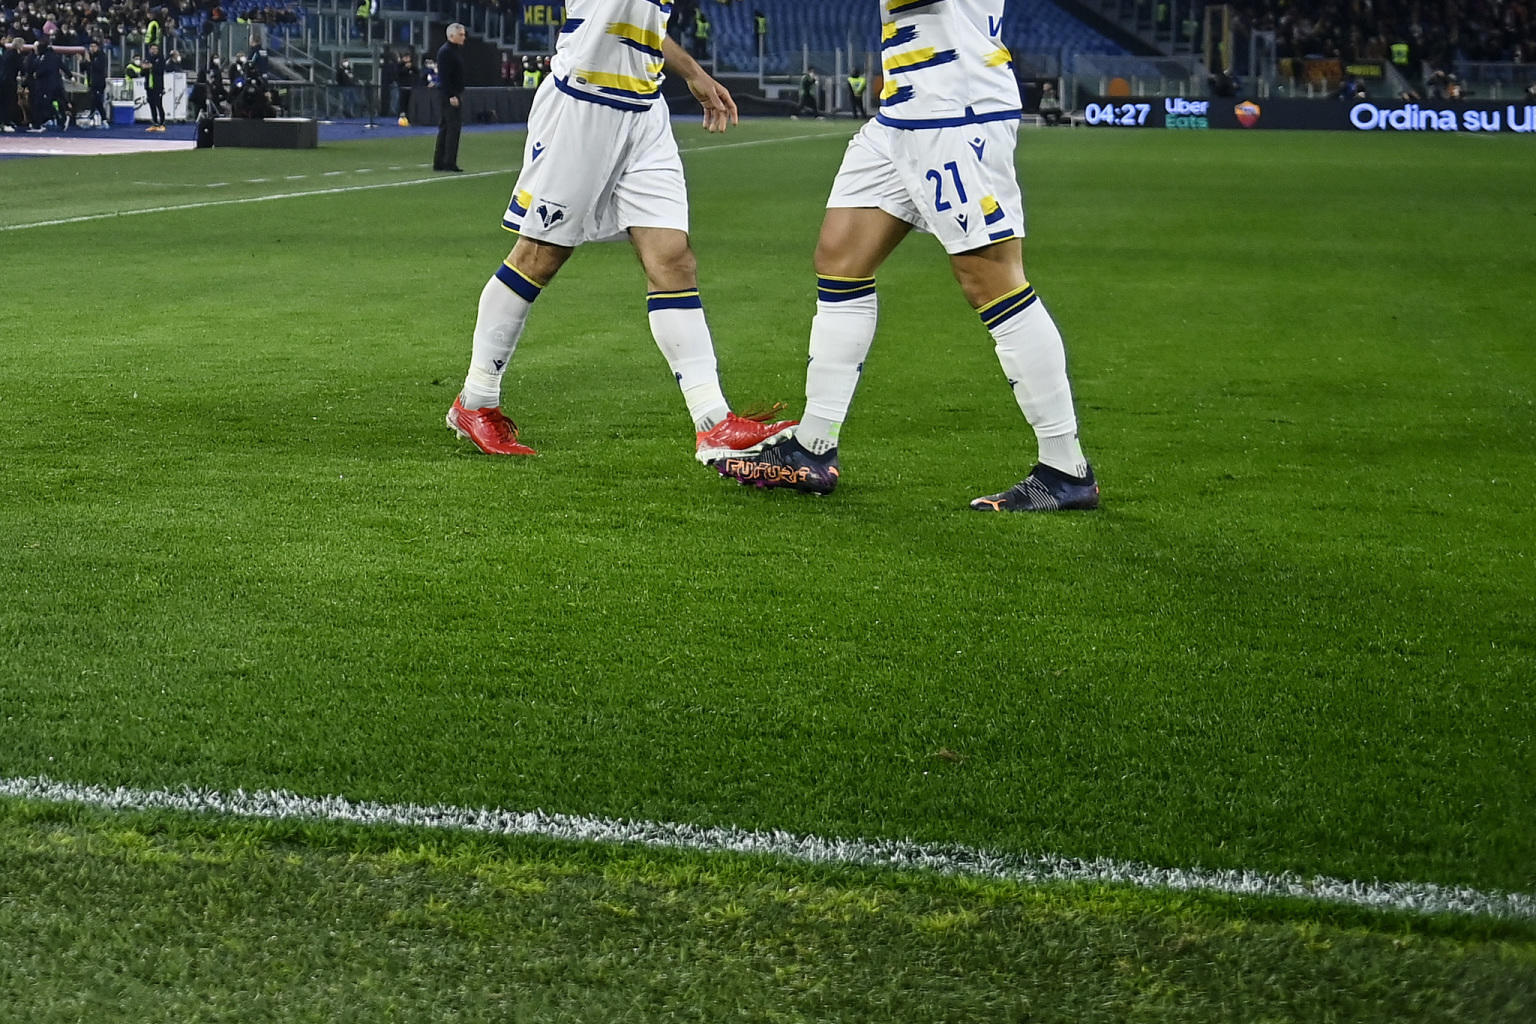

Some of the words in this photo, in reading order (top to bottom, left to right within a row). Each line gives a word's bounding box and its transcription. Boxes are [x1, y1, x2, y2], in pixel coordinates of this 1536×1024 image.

[1085, 103, 1151, 126] 04:27
[1165, 97, 1209, 115] Uber
[1350, 103, 1459, 131] Ordina
[1463, 110, 1501, 132] su
[1165, 114, 1209, 129] Eats
[925, 161, 968, 213] 21
